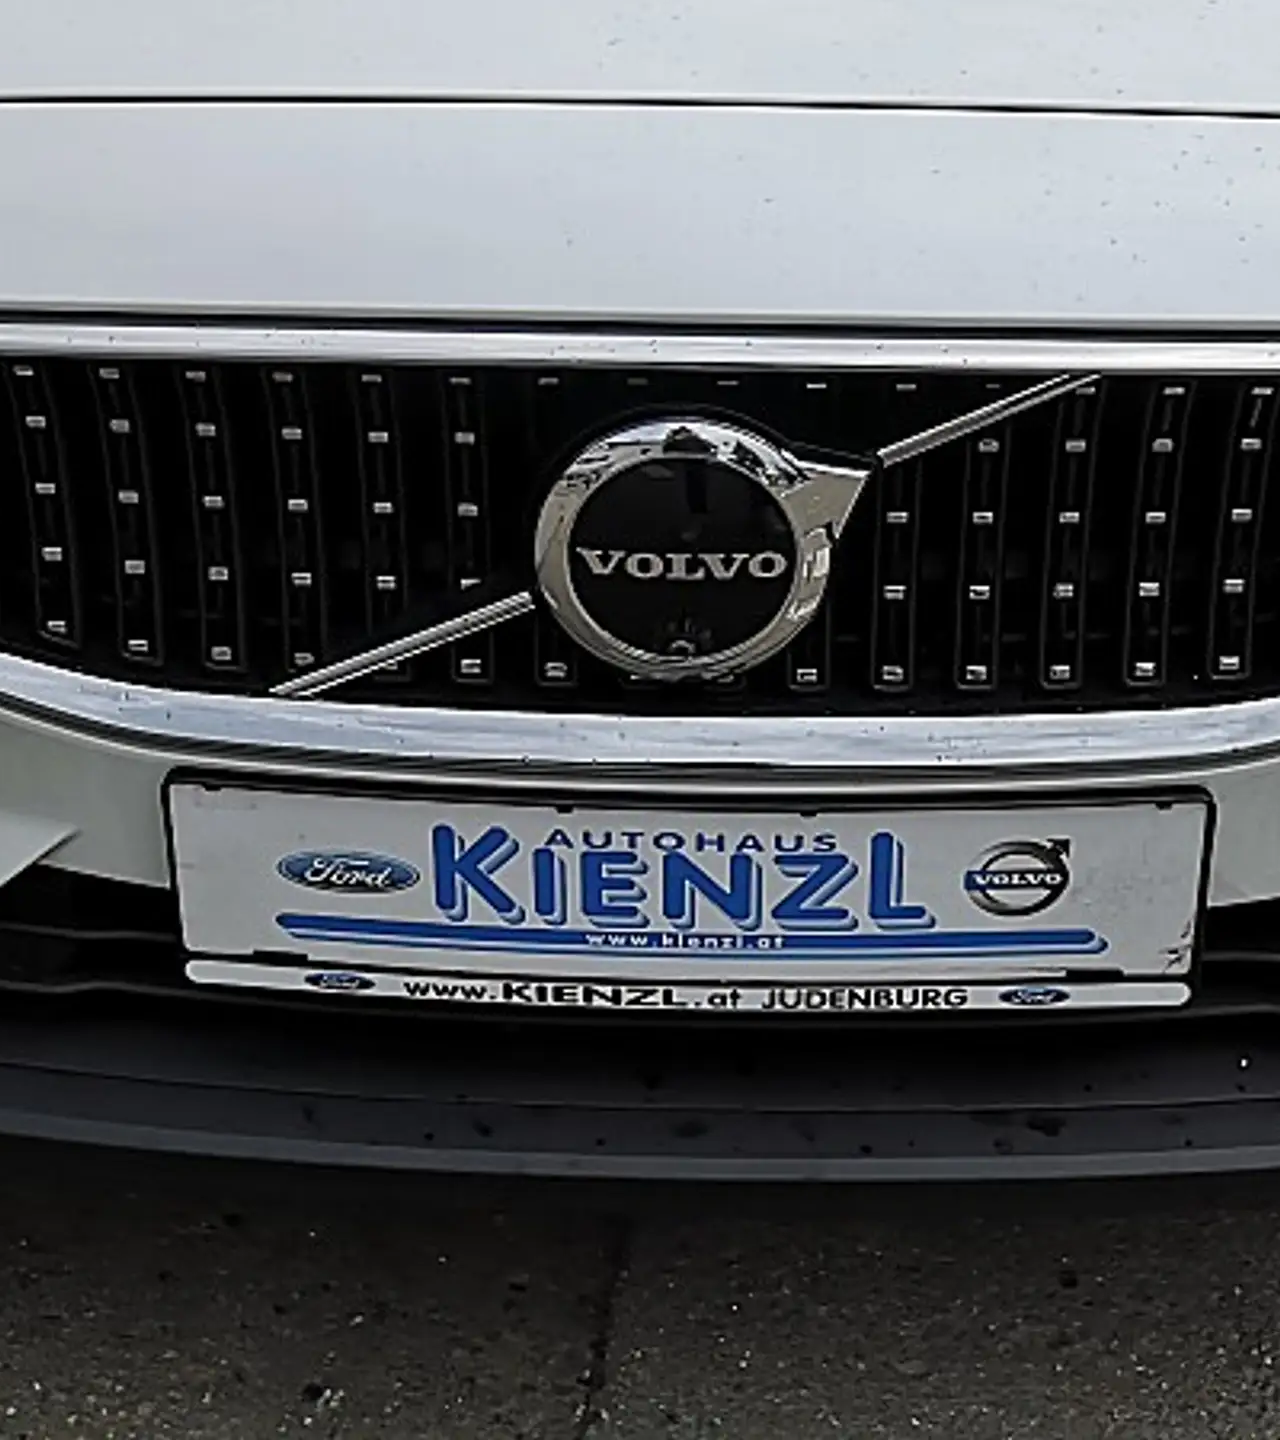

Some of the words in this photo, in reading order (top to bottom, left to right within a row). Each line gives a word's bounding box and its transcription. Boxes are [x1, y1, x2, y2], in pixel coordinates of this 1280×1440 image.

[576, 546, 787, 580] VOLVO
[545, 828, 837, 853] AUTOHAUS
[304, 857, 392, 888] Ford
[432, 824, 936, 931] KIENZL
[973, 871, 1064, 885] VOLVO
[586, 933, 783, 949] www.kienzl.at
[404, 982, 741, 1007] www.KIENZL.at
[761, 989, 968, 1010] JUDENBURG
